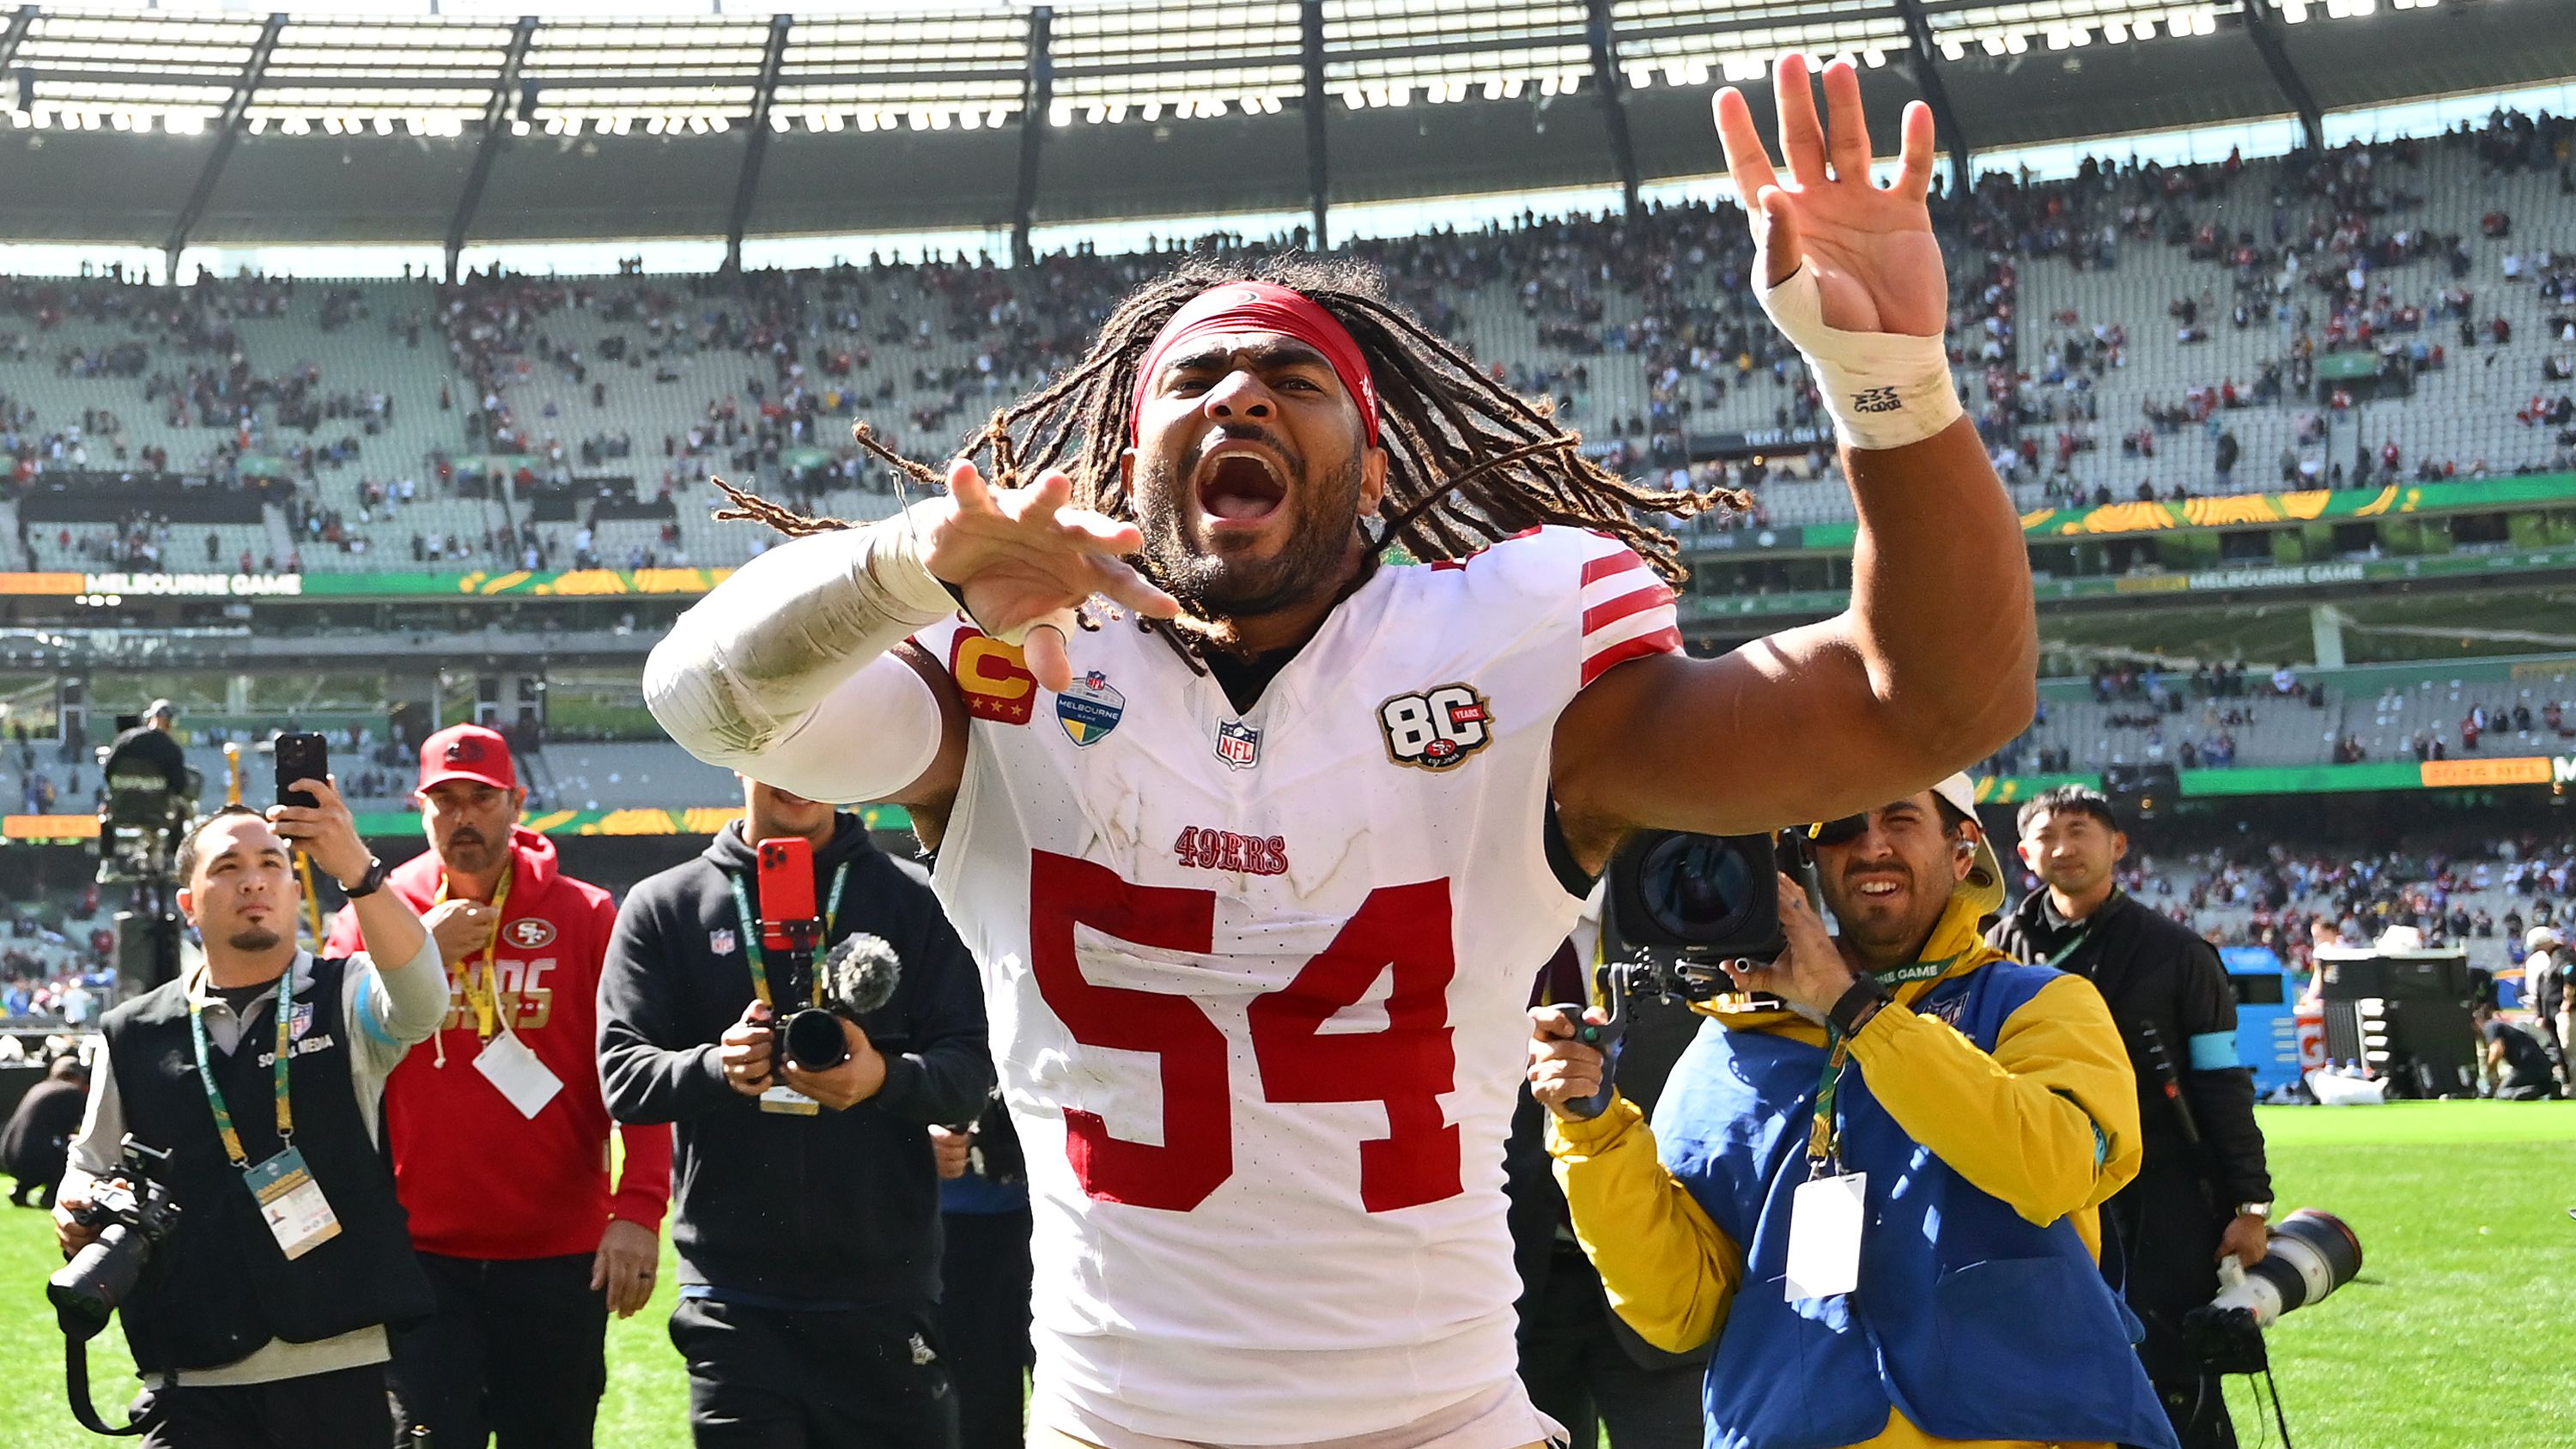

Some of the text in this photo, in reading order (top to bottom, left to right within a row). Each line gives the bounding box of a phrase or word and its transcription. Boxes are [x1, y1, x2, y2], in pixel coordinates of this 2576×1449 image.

[86, 573, 228, 595] MELBOURNE
[231, 573, 301, 595] GAME
[2190, 567, 2305, 589] MELBOURNE
[2307, 563, 2364, 583] GAME
[956, 636, 1030, 699] C
[1059, 700, 1119, 720] MELBOURNE
[1454, 708, 1479, 720] YEARS
[1220, 737, 1251, 761] NFL
[1175, 826, 1288, 876] 49ERS
[1897, 965, 1938, 980] GAME
[1030, 848, 1464, 1213] 54
